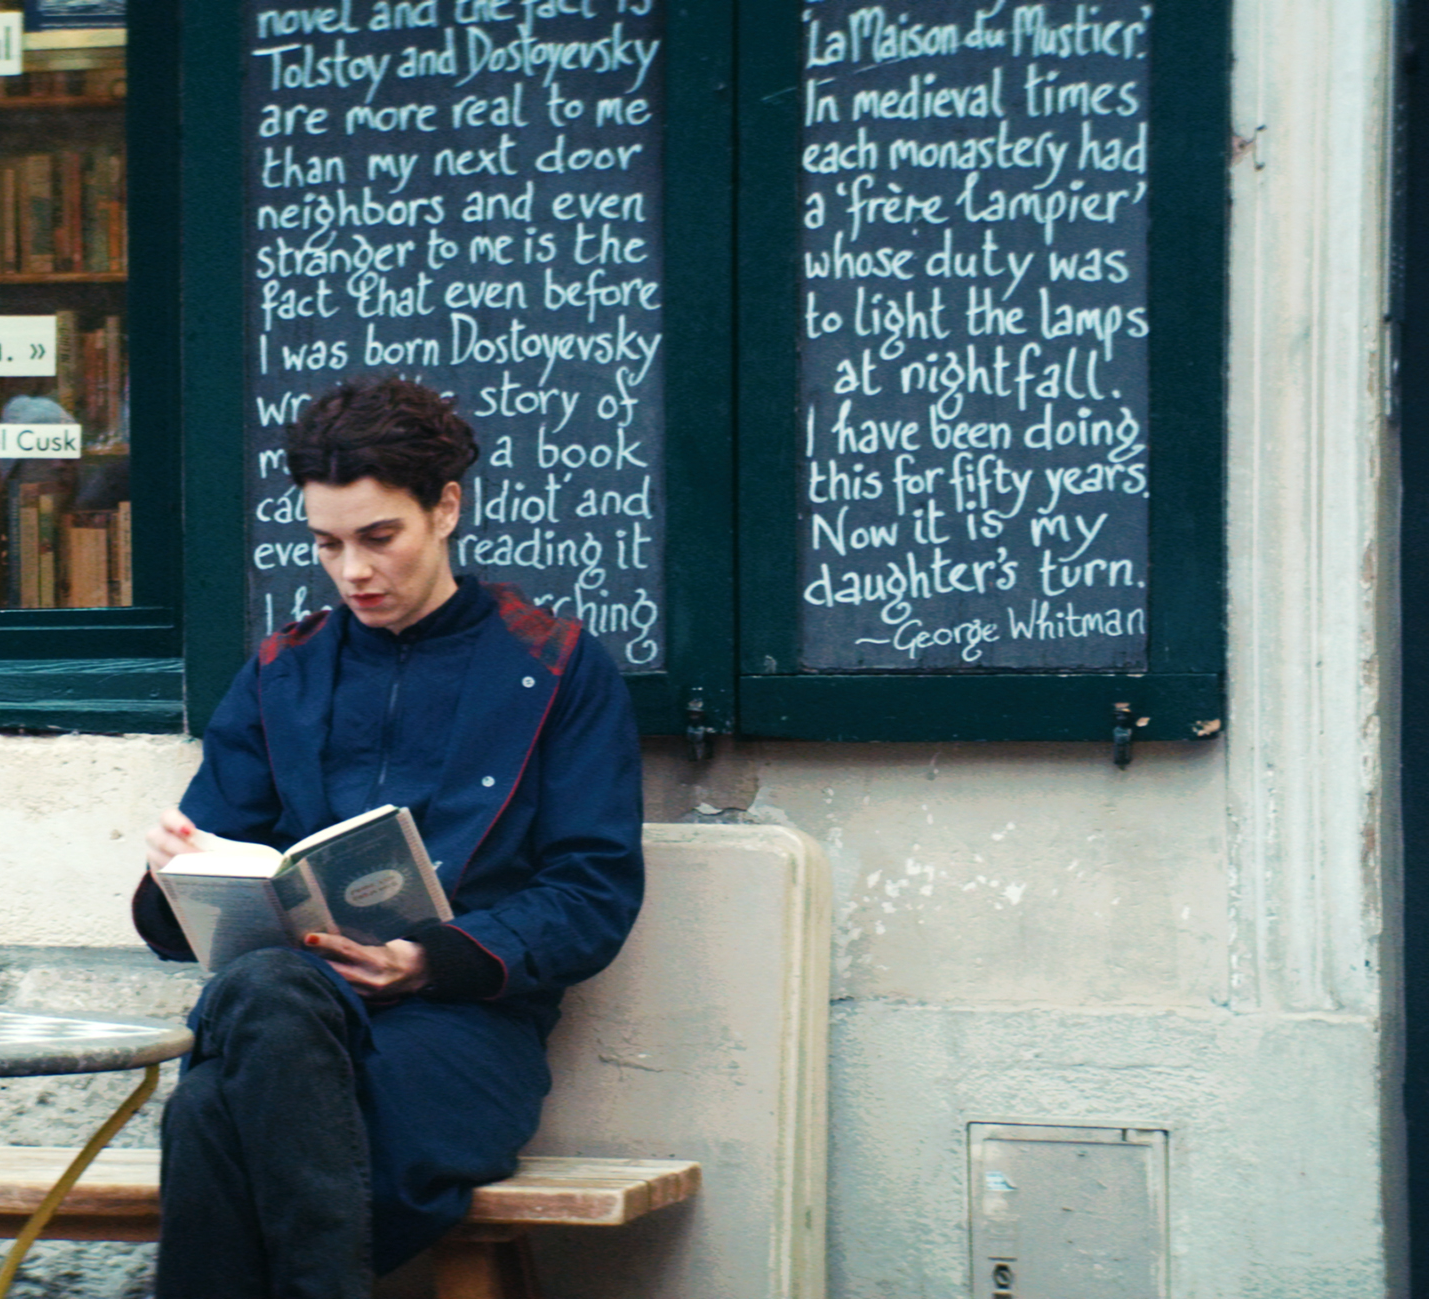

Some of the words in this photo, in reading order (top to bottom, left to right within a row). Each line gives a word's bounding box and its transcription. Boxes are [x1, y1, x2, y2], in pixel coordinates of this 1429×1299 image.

[258, 0, 359, 38] novel
[370, 0, 438, 30] and
[454, 0, 515, 25] the
[522, 0, 597, 36] fact
[850, 7, 958, 63] Maison
[964, 10, 1005, 49] du
[252, 39, 390, 104] Tolstoy
[397, 28, 457, 78] and
[454, 22, 661, 94] Dostoyevsky
[806, 78, 840, 126] In
[852, 67, 1004, 121] medieval
[1024, 64, 1138, 117] times
[259, 103, 328, 137] are
[346, 103, 438, 135] more
[452, 82, 529, 129] real
[547, 82, 583, 127] to
[596, 97, 652, 128] me
[261, 146, 346, 188] than
[368, 153, 419, 194] my
[434, 133, 518, 176] next
[535, 134, 642, 174] door
[802, 127, 877, 173] each
[889, 120, 1068, 190] monastery
[1079, 120, 1147, 174] had
[258, 187, 444, 251] neighbors
[461, 180, 533, 222] and
[552, 192, 645, 221] even
[805, 193, 824, 229] a
[257, 234, 415, 297] stranger
[428, 228, 458, 270] to
[471, 233, 514, 265] me
[524, 227, 557, 264] is
[574, 222, 648, 265] the
[805, 231, 915, 280] whose
[926, 228, 1034, 301] duty
[1050, 249, 1129, 283] was
[261, 279, 339, 331] fact
[358, 272, 436, 318] that
[444, 280, 527, 309] even
[544, 267, 662, 323] before
[805, 292, 842, 339] to
[855, 286, 950, 360] light
[967, 286, 1027, 337] the
[1039, 287, 1149, 361] lamps
[260, 334, 268, 374] I
[282, 339, 348, 371] was
[365, 323, 439, 366] born
[450, 312, 662, 387] Dostoyevsky
[834, 349, 882, 395] at
[901, 343, 1122, 420] nightfall.
[474, 370, 580, 434] story
[597, 366, 638, 427] of
[806, 404, 814, 457] I
[832, 399, 921, 454] have
[929, 404, 1012, 450] been
[1024, 402, 1147, 463] doing
[17, 429, 77, 451] Cusk
[490, 435, 513, 468] a
[538, 422, 648, 470] book
[576, 475, 652, 520] and
[809, 459, 883, 503] this
[893, 454, 945, 516] for
[949, 452, 1033, 519] fifty
[1037, 463, 1150, 514] years.
[458, 528, 606, 590] reading
[616, 523, 652, 569] it
[812, 506, 898, 556] Now
[913, 499, 950, 544] it
[967, 501, 1004, 540] is
[1031, 513, 1108, 563] my
[265, 593, 273, 636] I
[804, 547, 1018, 625] daughter's
[1040, 549, 1146, 596] turn.
[1008, 598, 1145, 640] Whitman
